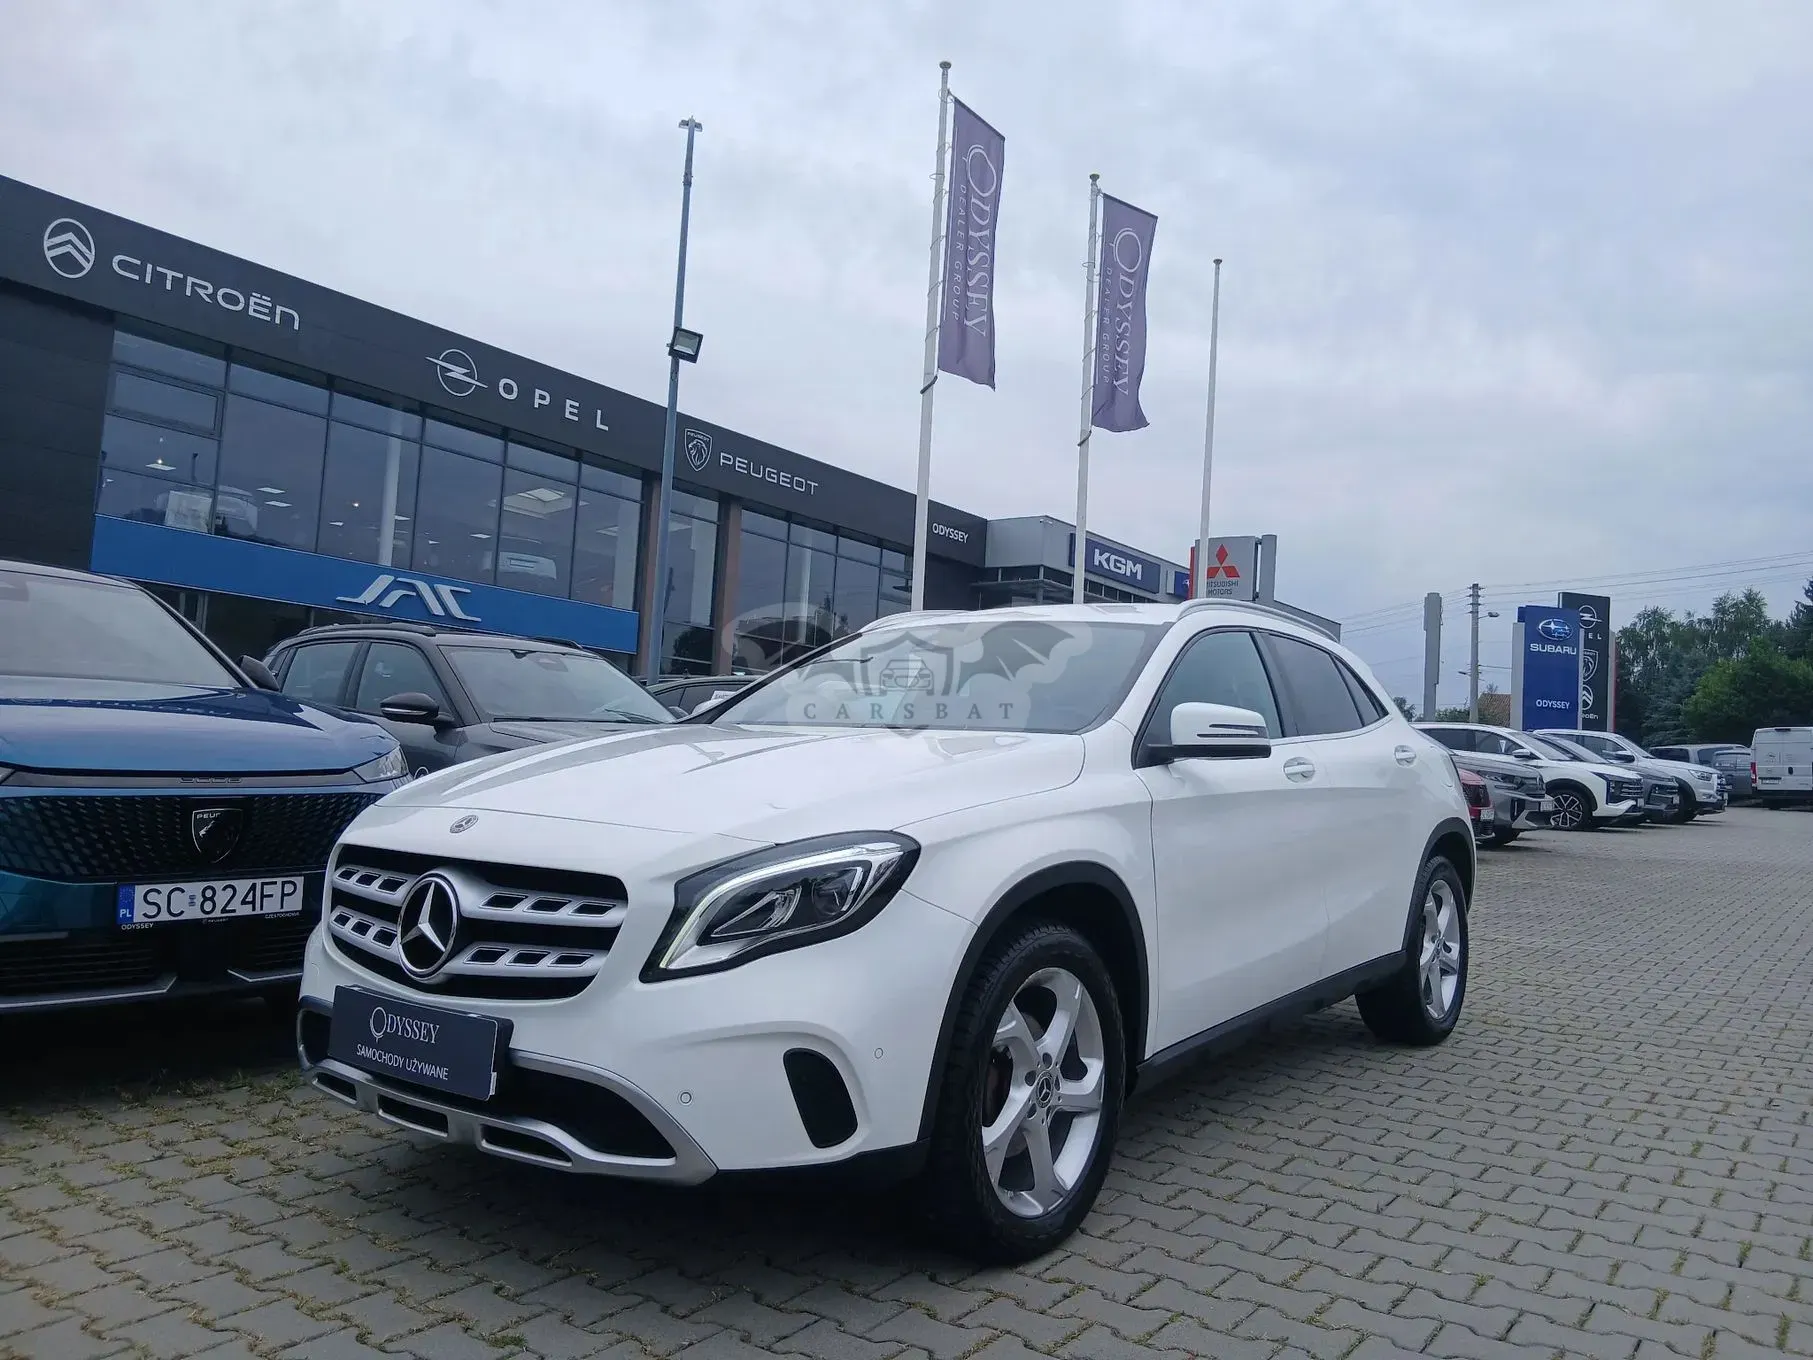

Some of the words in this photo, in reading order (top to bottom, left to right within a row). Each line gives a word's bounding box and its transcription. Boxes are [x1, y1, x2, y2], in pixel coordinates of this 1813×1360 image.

[955, 184, 966, 250] DEALER
[962, 144, 997, 337] ODYSSEY
[952, 260, 963, 321] GROUP
[1103, 266, 1113, 323] DEALER
[1109, 227, 1142, 396] ODYSSEY
[1102, 333, 1110, 384] GROUP
[498, 378, 609, 431] OPEL
[720, 452, 819, 495] PEUGEOT
[932, 523, 969, 543] ODYSSEY
[1093, 548, 1142, 581] KGM
[335, 574, 482, 622] JAC
[1529, 643, 1577, 655] SUBARU
[1535, 699, 1570, 710] ODYSSEY
[119, 908, 132, 918] PL
[141, 886, 186, 919] SC
[200, 880, 298, 915] 824FP
[121, 922, 154, 931] ODYSSEY
[369, 1006, 440, 1044] ODYSSEY
[356, 1043, 405, 1069] SAMOCHODY
[405, 1057, 449, 1081] UŻYWANE
